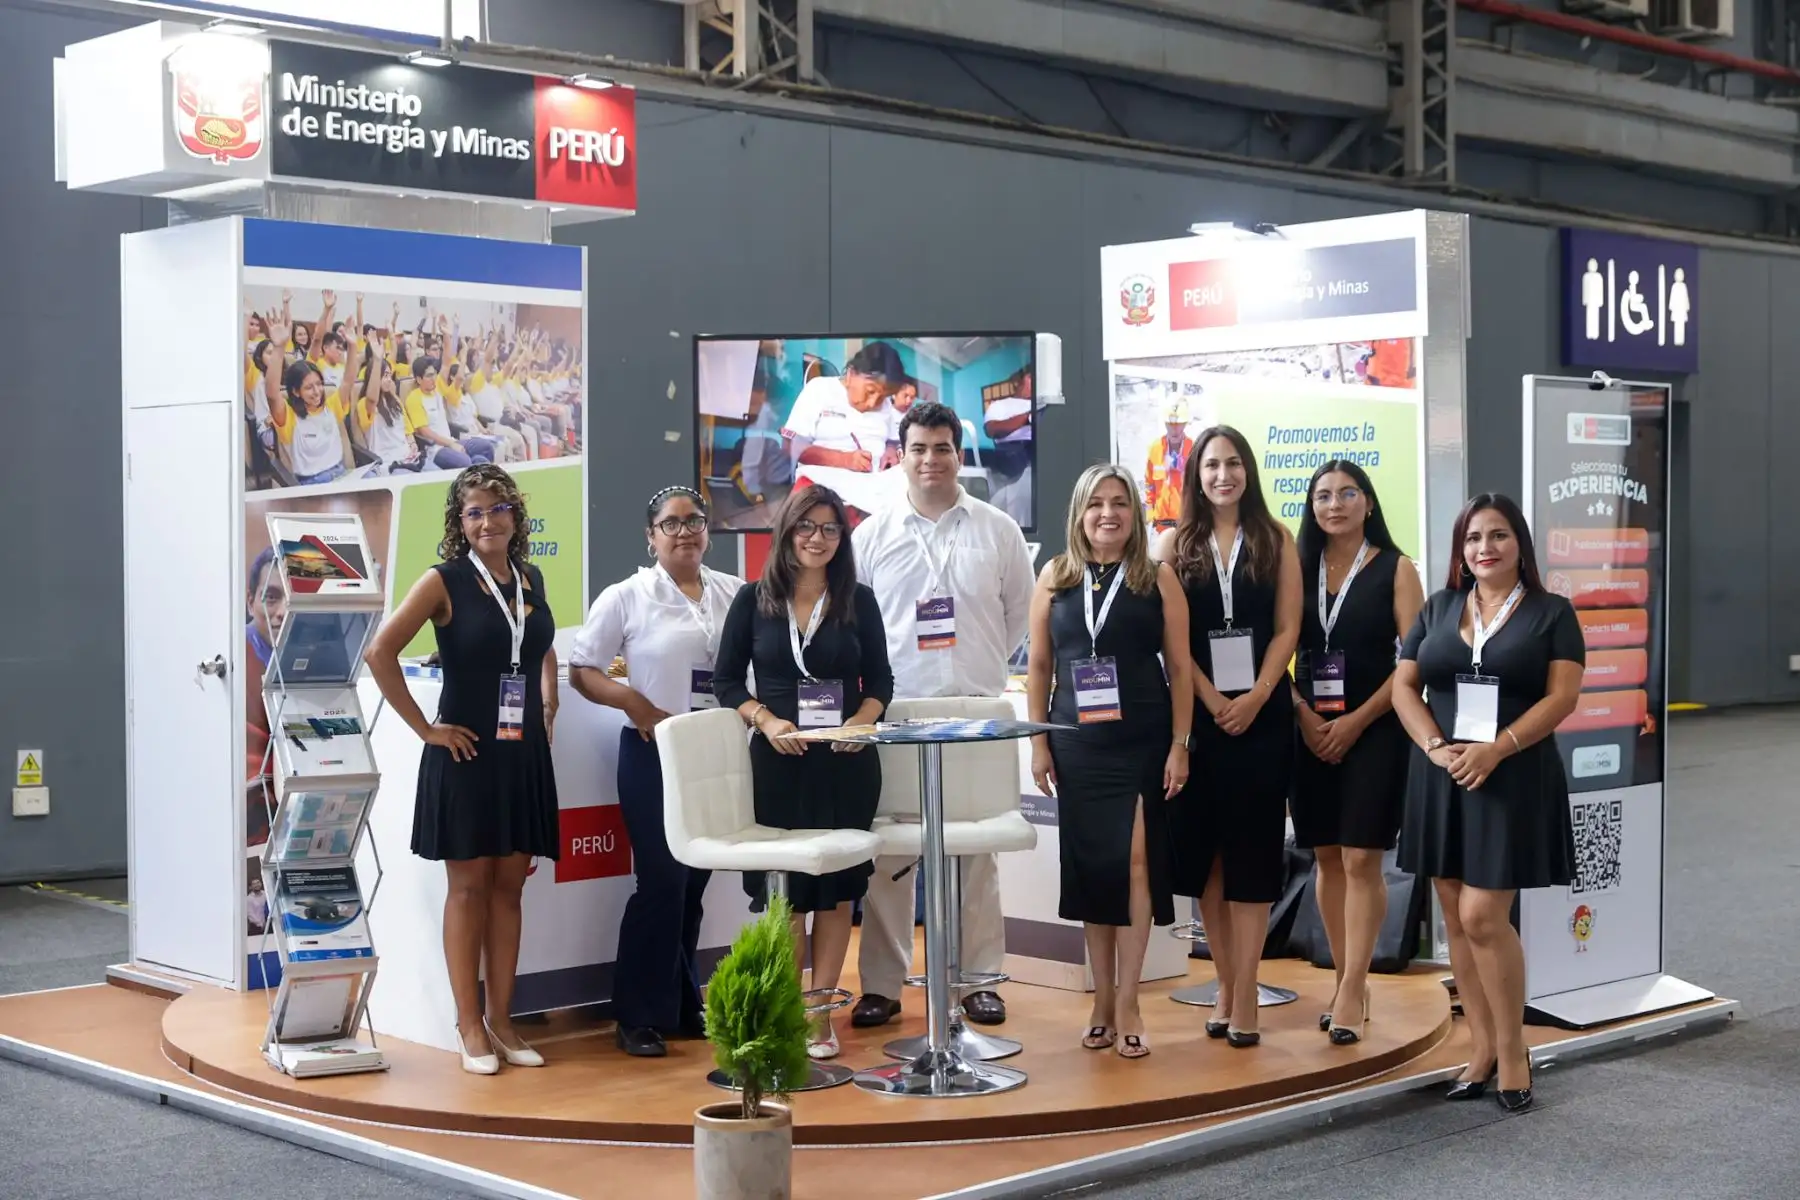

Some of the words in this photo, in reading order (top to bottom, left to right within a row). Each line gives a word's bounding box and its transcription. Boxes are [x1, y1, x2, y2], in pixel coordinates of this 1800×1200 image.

[282, 72, 422, 116] Ministerio
[281, 108, 319, 138] de
[430, 128, 448, 157] y
[452, 126, 531, 160] Minas
[549, 127, 625, 167] PERÚ
[1317, 284, 1325, 301] y
[1328, 279, 1369, 296] Minas
[1268, 424, 1358, 444] Promovemos
[1362, 422, 1375, 441] la
[1264, 449, 1326, 469] inversión
[1331, 448, 1379, 467] minera
[1571, 460, 1617, 474] Selecciona
[1619, 464, 1628, 476] tu
[1549, 475, 1648, 504] EXPERIENCIA
[1082, 676, 1110, 684] INDUMIN
[572, 829, 615, 856] PERÚ
